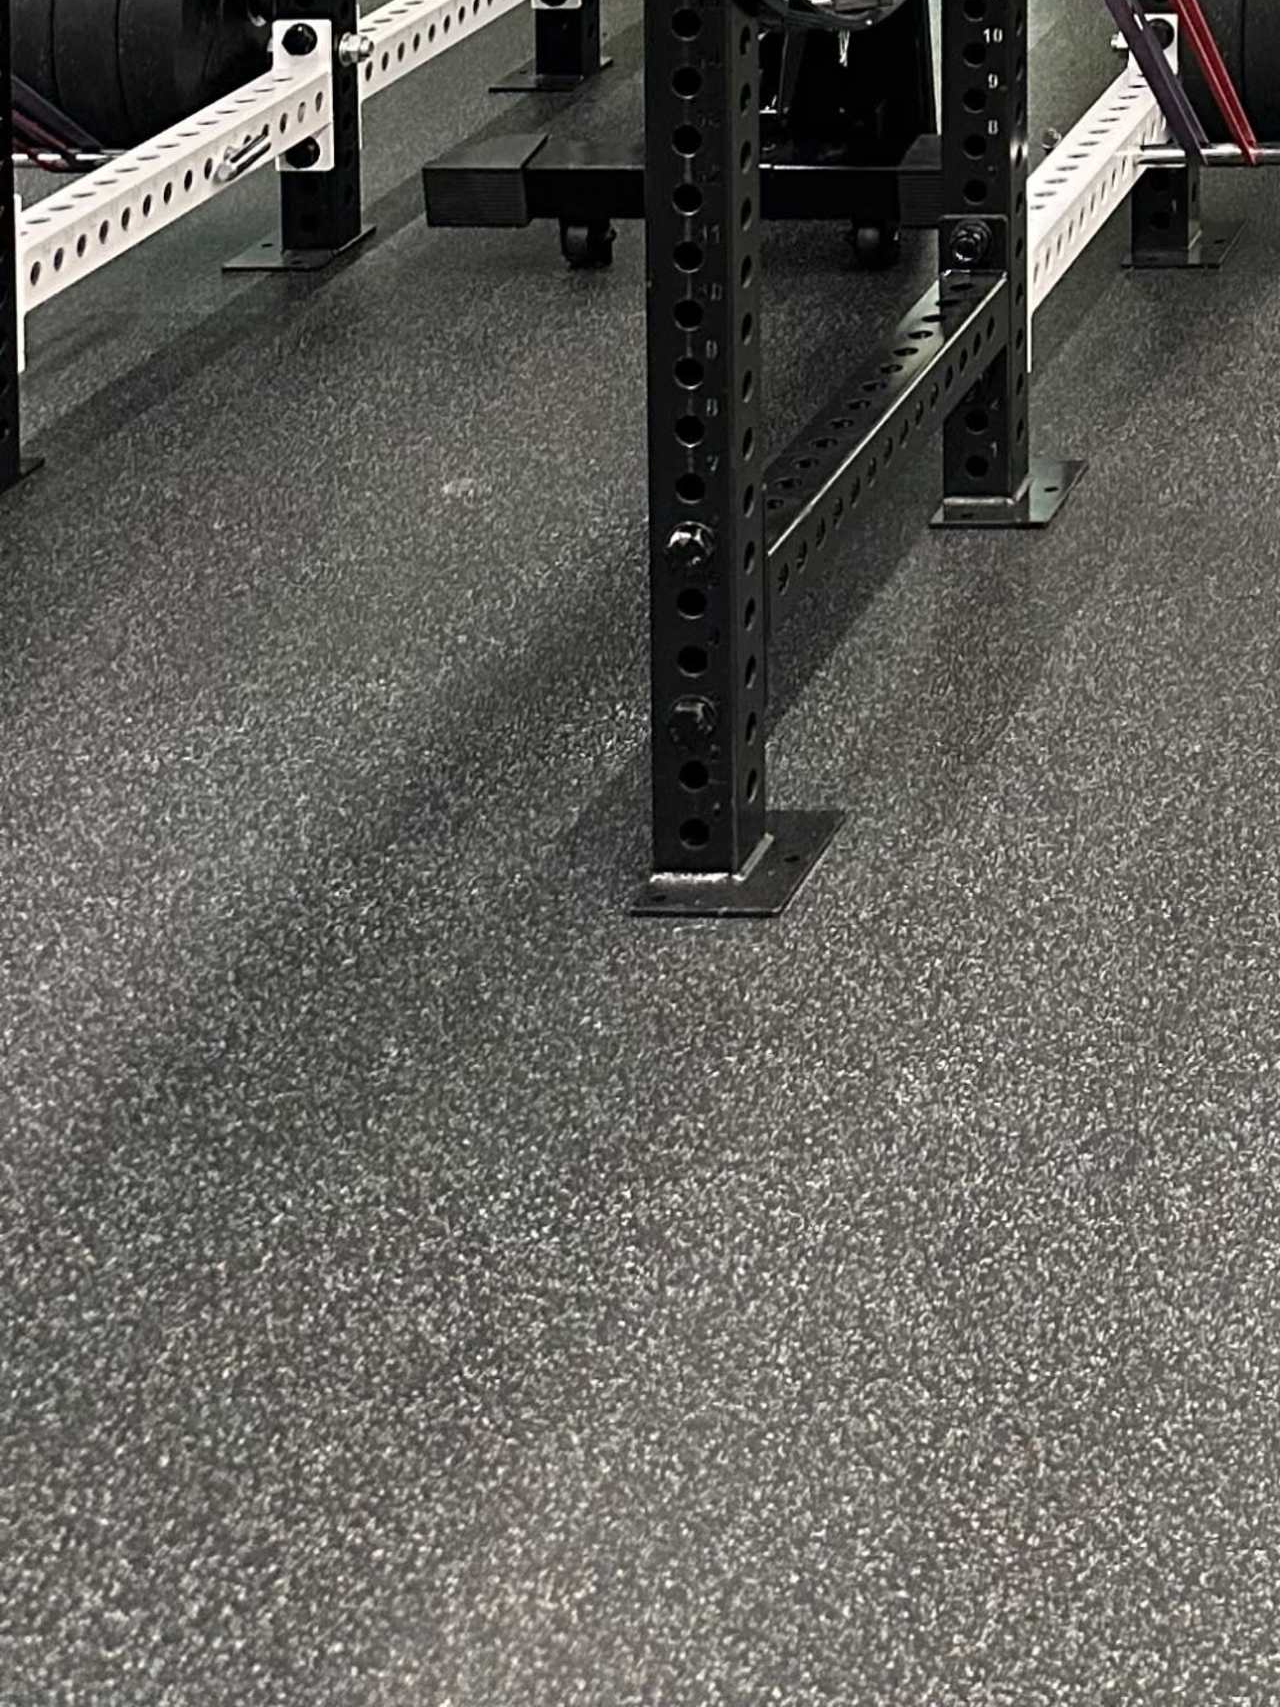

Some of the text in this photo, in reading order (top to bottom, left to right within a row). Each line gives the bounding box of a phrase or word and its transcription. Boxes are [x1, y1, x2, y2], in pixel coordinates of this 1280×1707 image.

[983, 28, 1003, 43] 10
[988, 72, 999, 89] 9
[988, 119, 999, 135] 8
